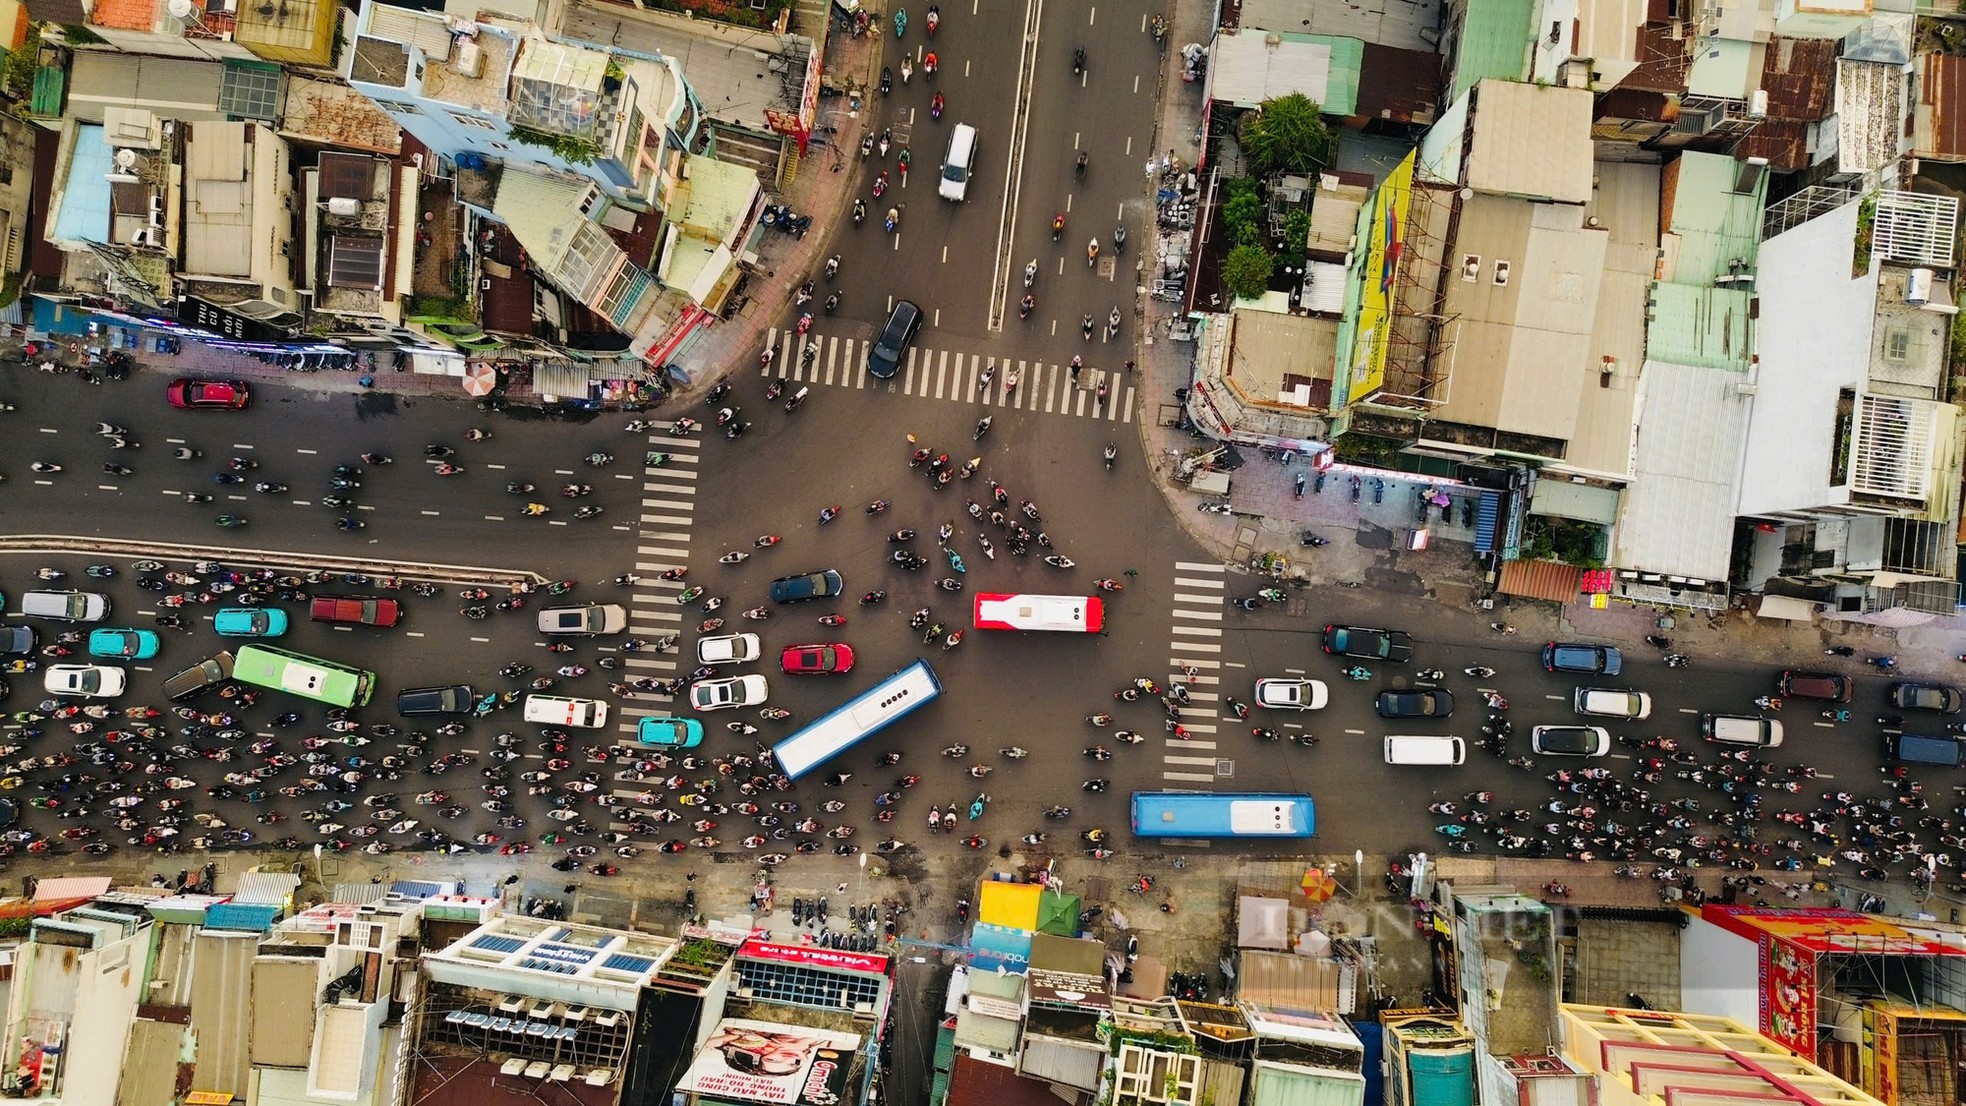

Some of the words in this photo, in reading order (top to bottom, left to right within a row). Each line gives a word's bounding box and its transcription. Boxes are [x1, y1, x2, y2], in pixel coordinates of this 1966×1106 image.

[198, 304, 208, 324] THU
[223, 315, 233, 334] ĐỔI
[446, 1010, 577, 1040] viettien
